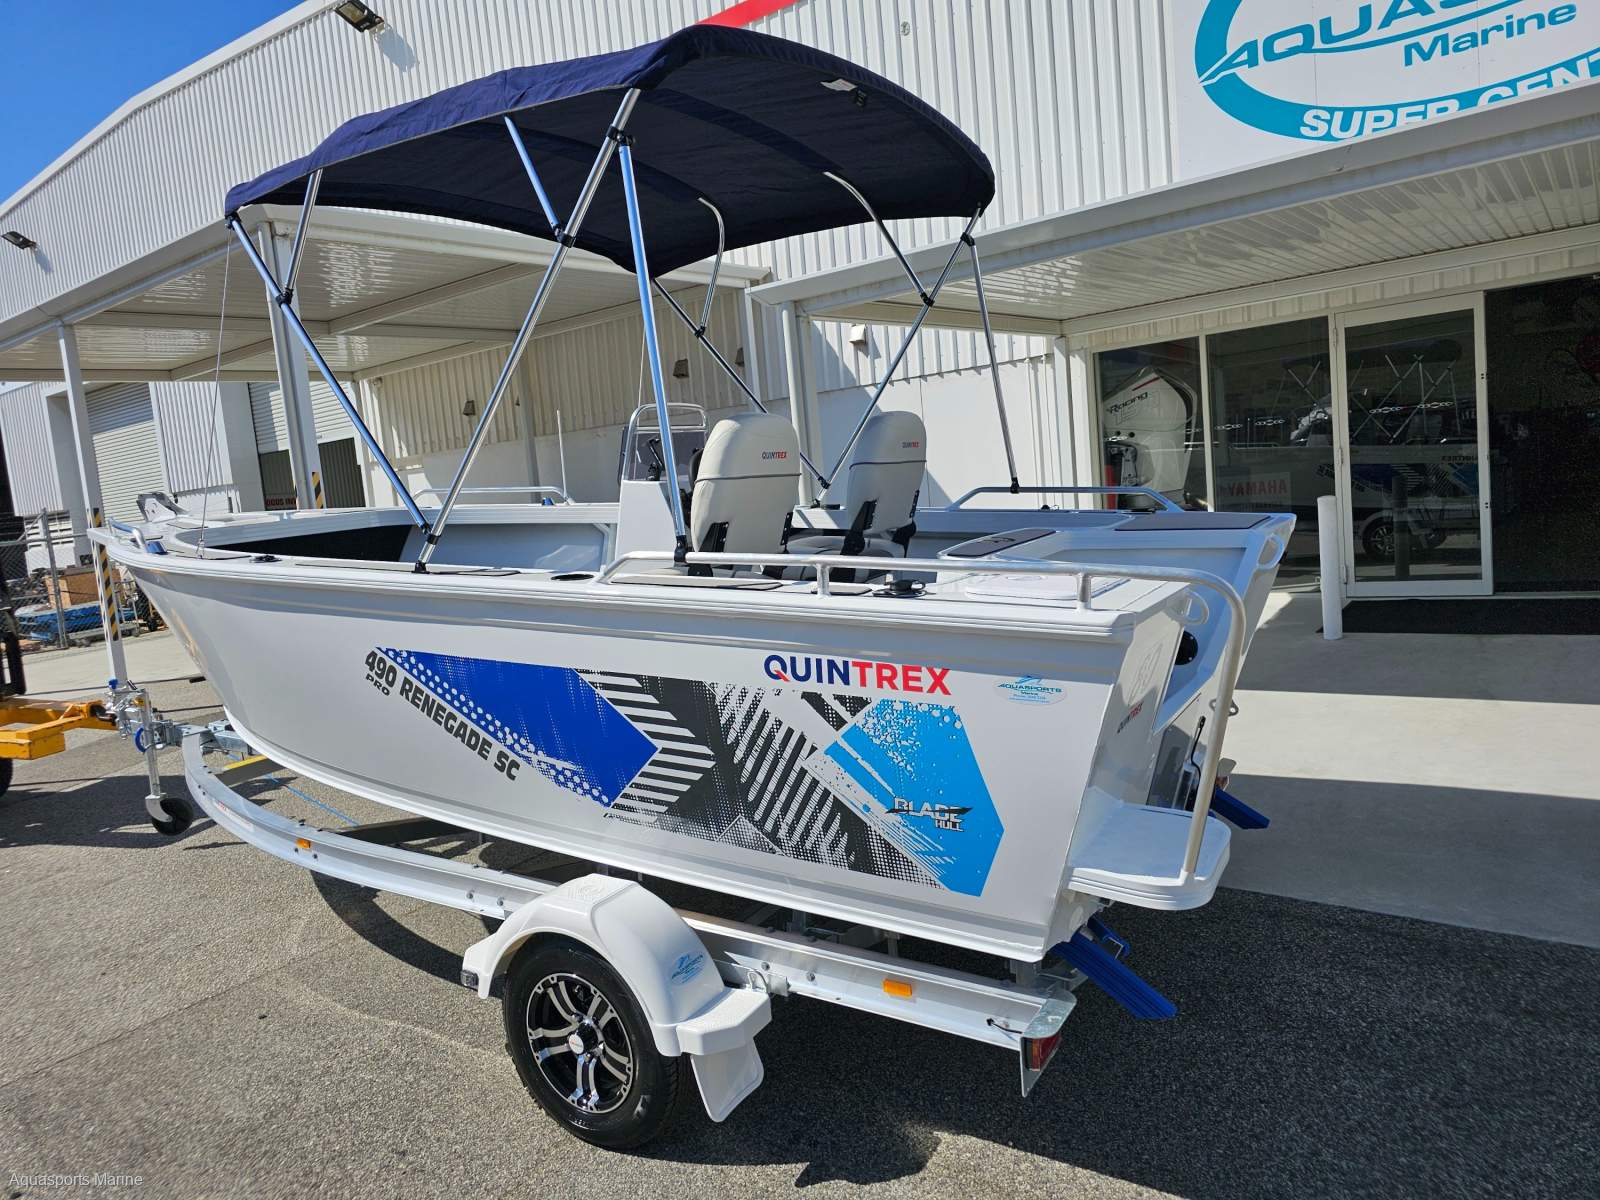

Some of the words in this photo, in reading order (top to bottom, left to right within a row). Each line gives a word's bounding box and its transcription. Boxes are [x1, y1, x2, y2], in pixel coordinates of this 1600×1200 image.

[1404, 3, 1577, 67] Marine
[761, 451, 788, 460] QUINTREX
[365, 673, 390, 697] PRO
[763, 654, 952, 696] QUINTREX
[364, 650, 398, 688] 490
[399, 676, 493, 761] RENEGADE
[493, 750, 521, 781] SC
[893, 797, 964, 823] BLADE
[935, 820, 964, 832] HULL
